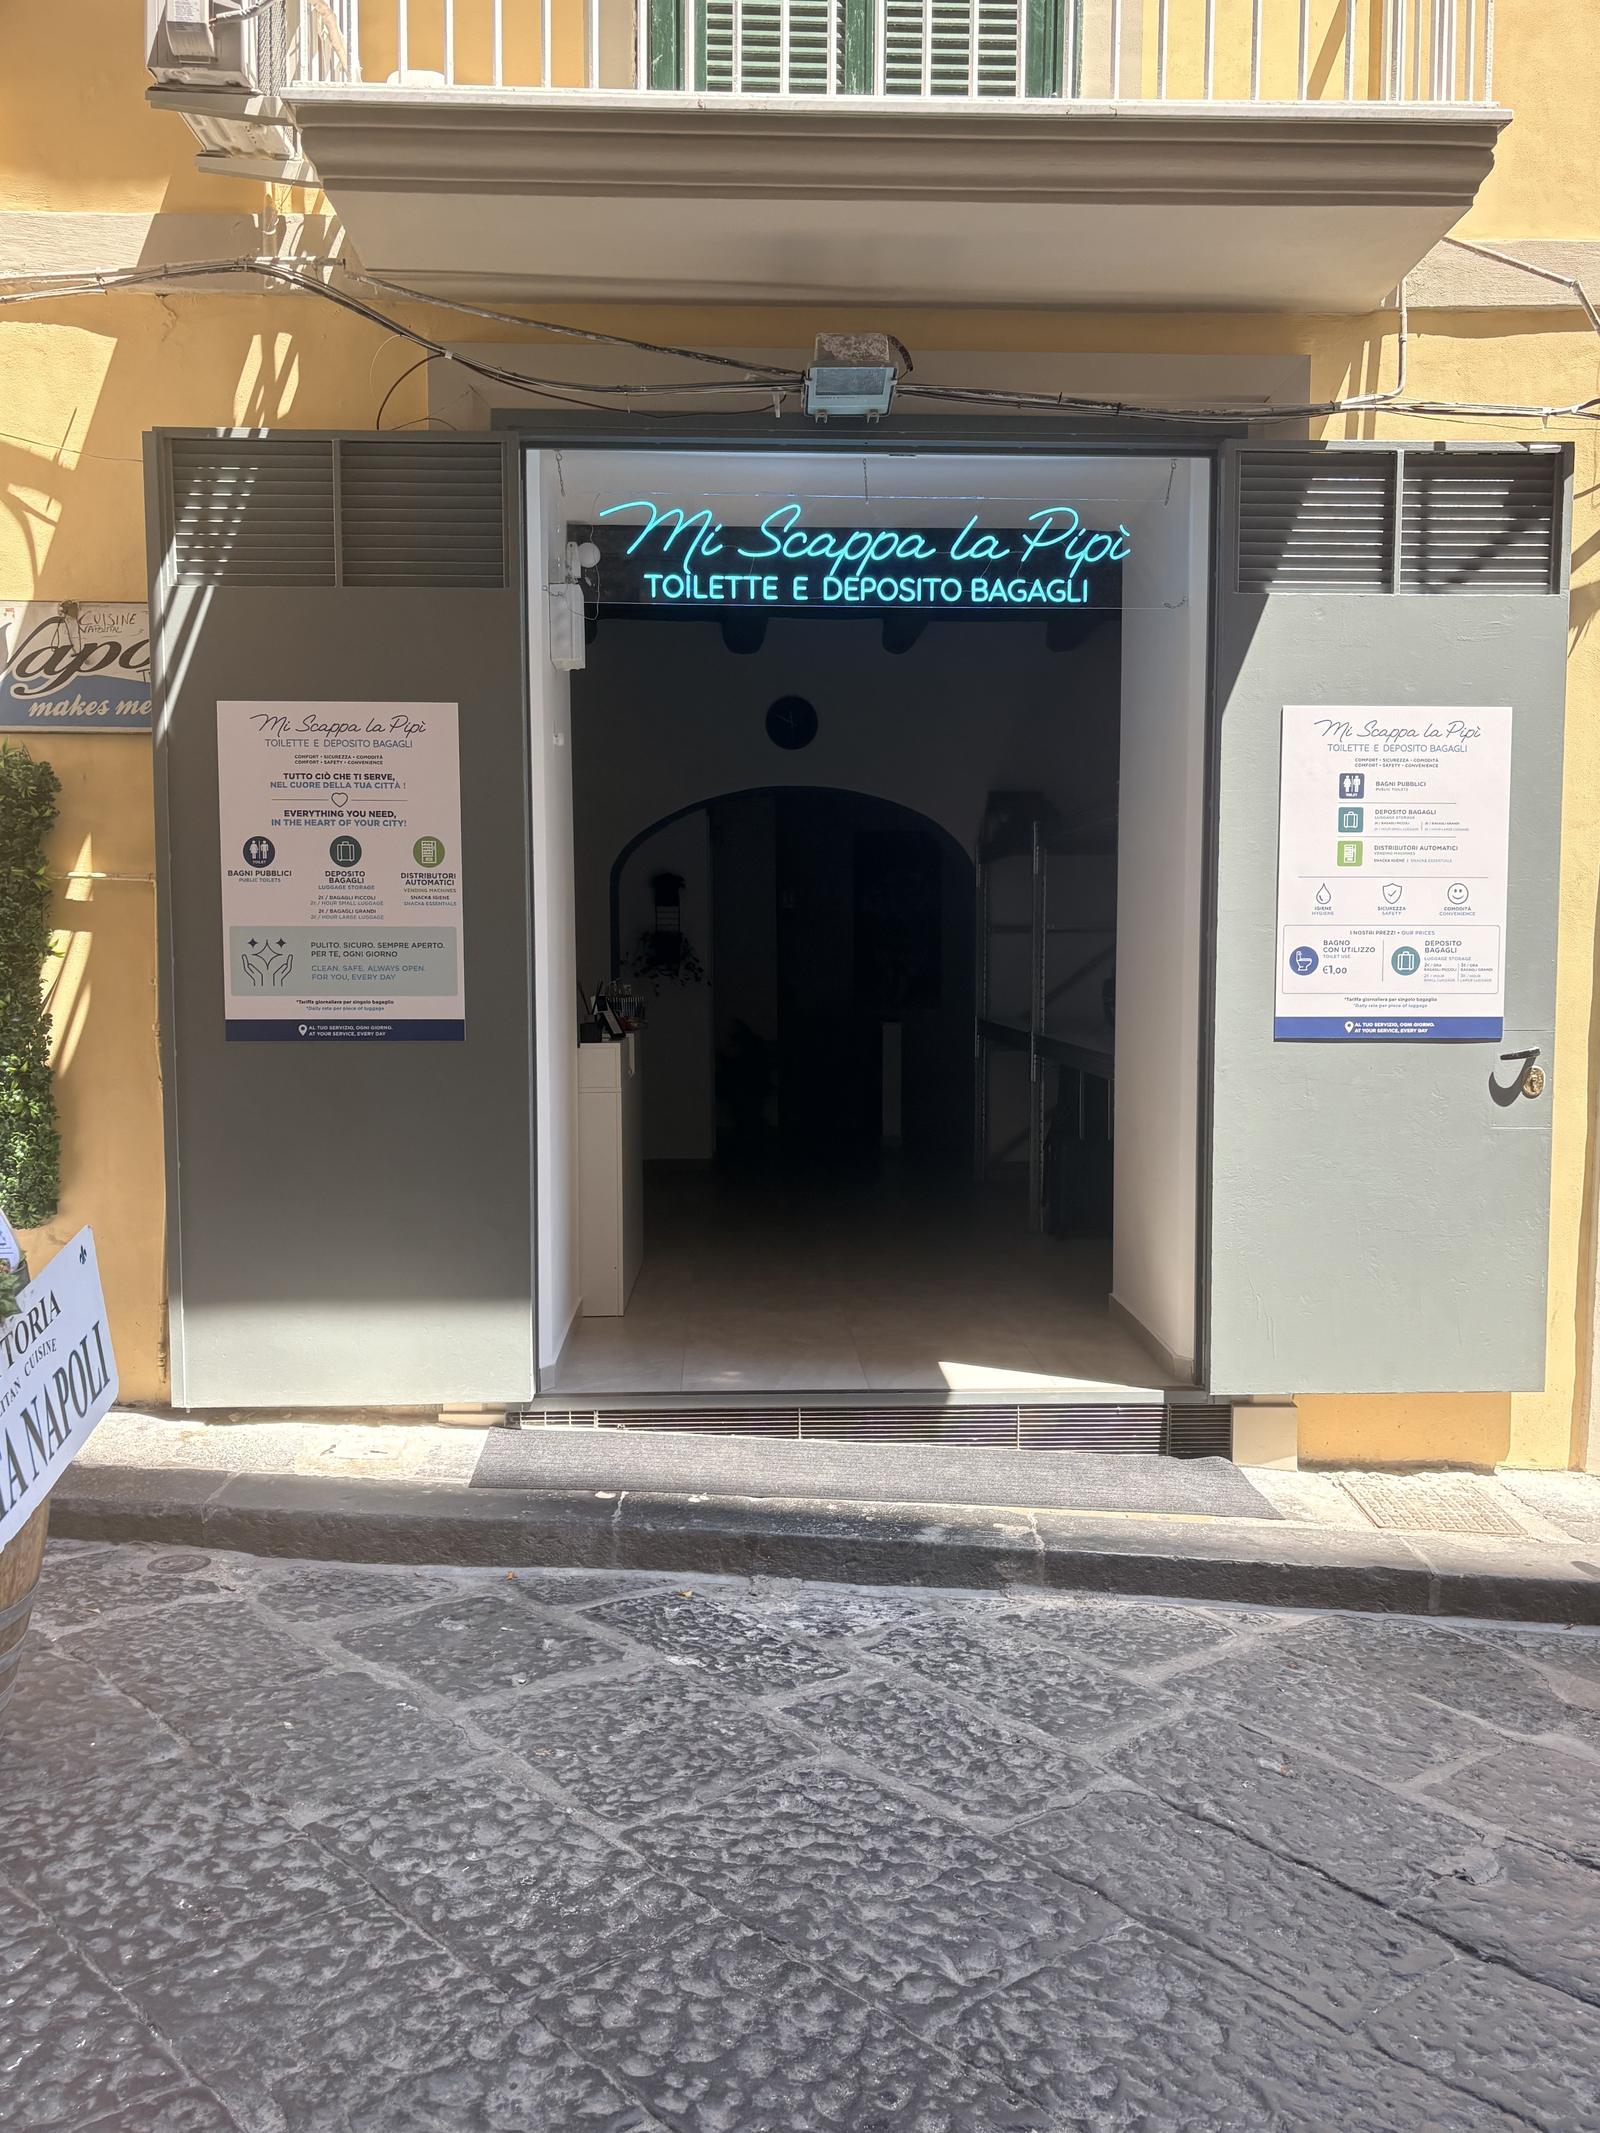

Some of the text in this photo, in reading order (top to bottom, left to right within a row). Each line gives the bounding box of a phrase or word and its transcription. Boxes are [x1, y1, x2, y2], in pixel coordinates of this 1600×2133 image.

[599, 501, 1131, 579] Mi Scappa la Pipì
[644, 573, 1089, 604] TOILETTE E DEPOSITO BAGAGLI
[79, 611, 136, 627] CUISINE
[29, 694, 110, 717] makes
[250, 714, 427, 738] Mi Scappa la Pipì
[1314, 719, 1481, 743] Mi Scappa la Pipì
[265, 739, 412, 748] TOILETTE E DEPOSITO BAGAGLI
[1327, 744, 1467, 752] TOILETTE E DEPOSITO BAGAGLI
[270, 780, 400, 789] NEL CUORE DELLA TUA CITTÀ
[315, 771, 331, 780] CIÒ
[364, 773, 395, 781] SERVE,
[271, 819, 282, 827] IN
[284, 819, 302, 827] THE
[304, 819, 336, 827] HEART
[338, 819, 352, 827] OF
[354, 819, 380, 827] YOUR
[369, 811, 396, 819] NEED,
[0, 1289, 61, 1369] TORIA
[24, 1338, 57, 1377] CUISINE
[20, 1321, 110, 1481] NAPOLI
